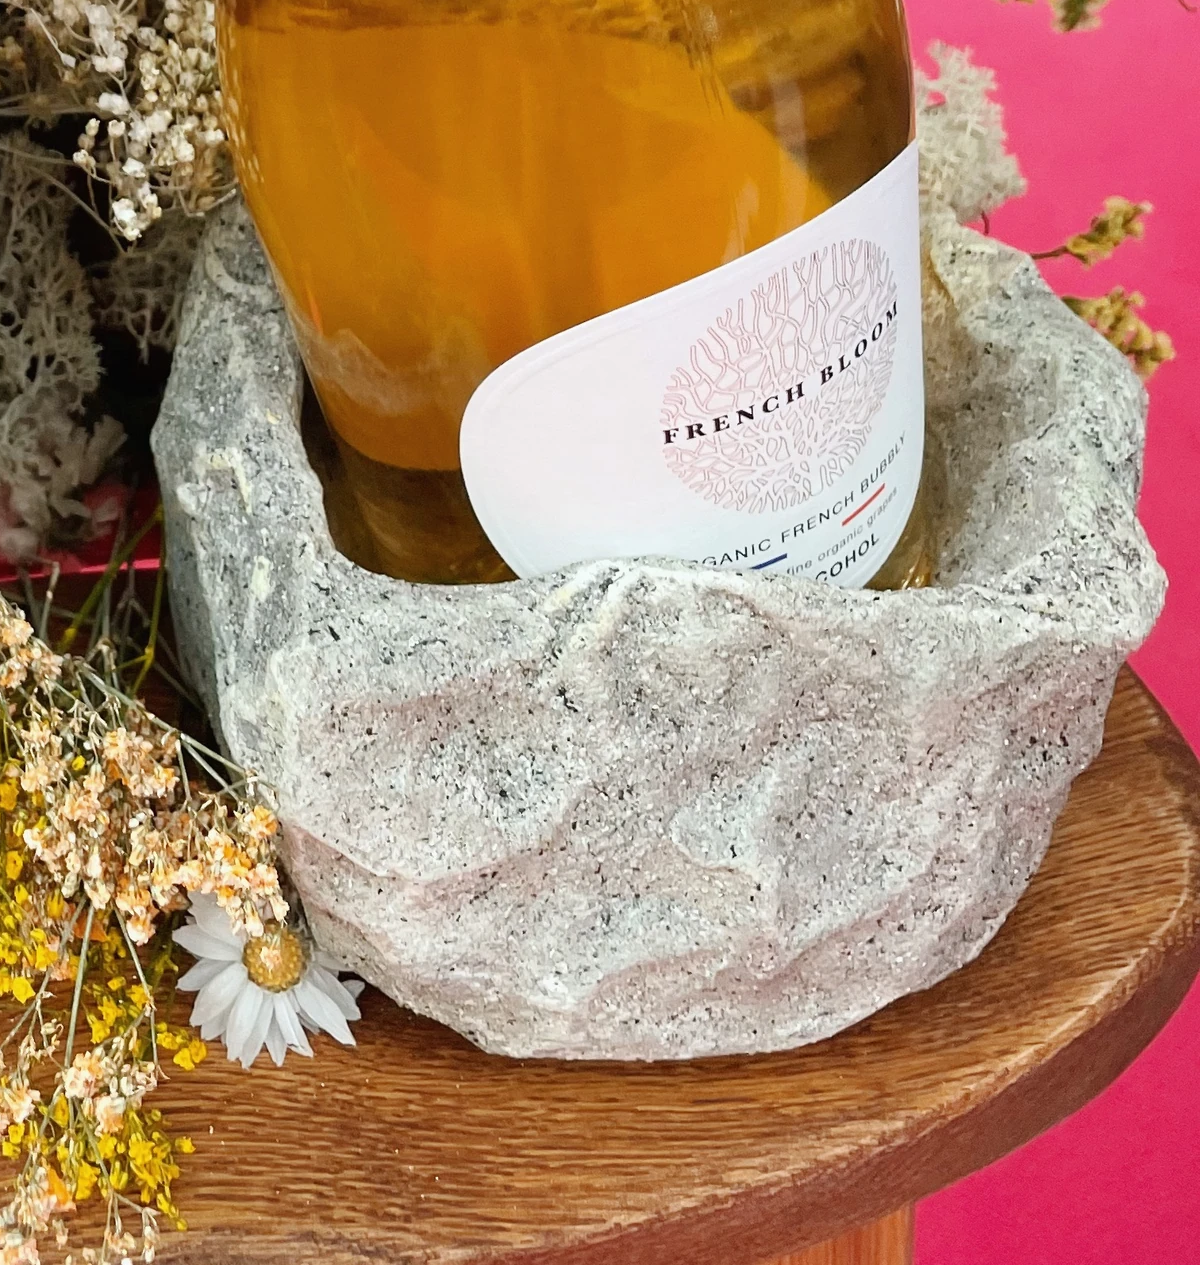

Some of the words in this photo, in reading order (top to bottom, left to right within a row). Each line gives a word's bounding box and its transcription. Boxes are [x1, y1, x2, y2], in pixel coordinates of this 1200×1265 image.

[663, 382, 805, 445] FRENCH
[819, 300, 898, 386] BLOOM
[689, 539, 772, 566] GANIC
[781, 491, 854, 543] FRENCH
[860, 429, 906, 493] BUBBLY
[817, 524, 863, 562] organic
[815, 533, 880, 581] COHOL
